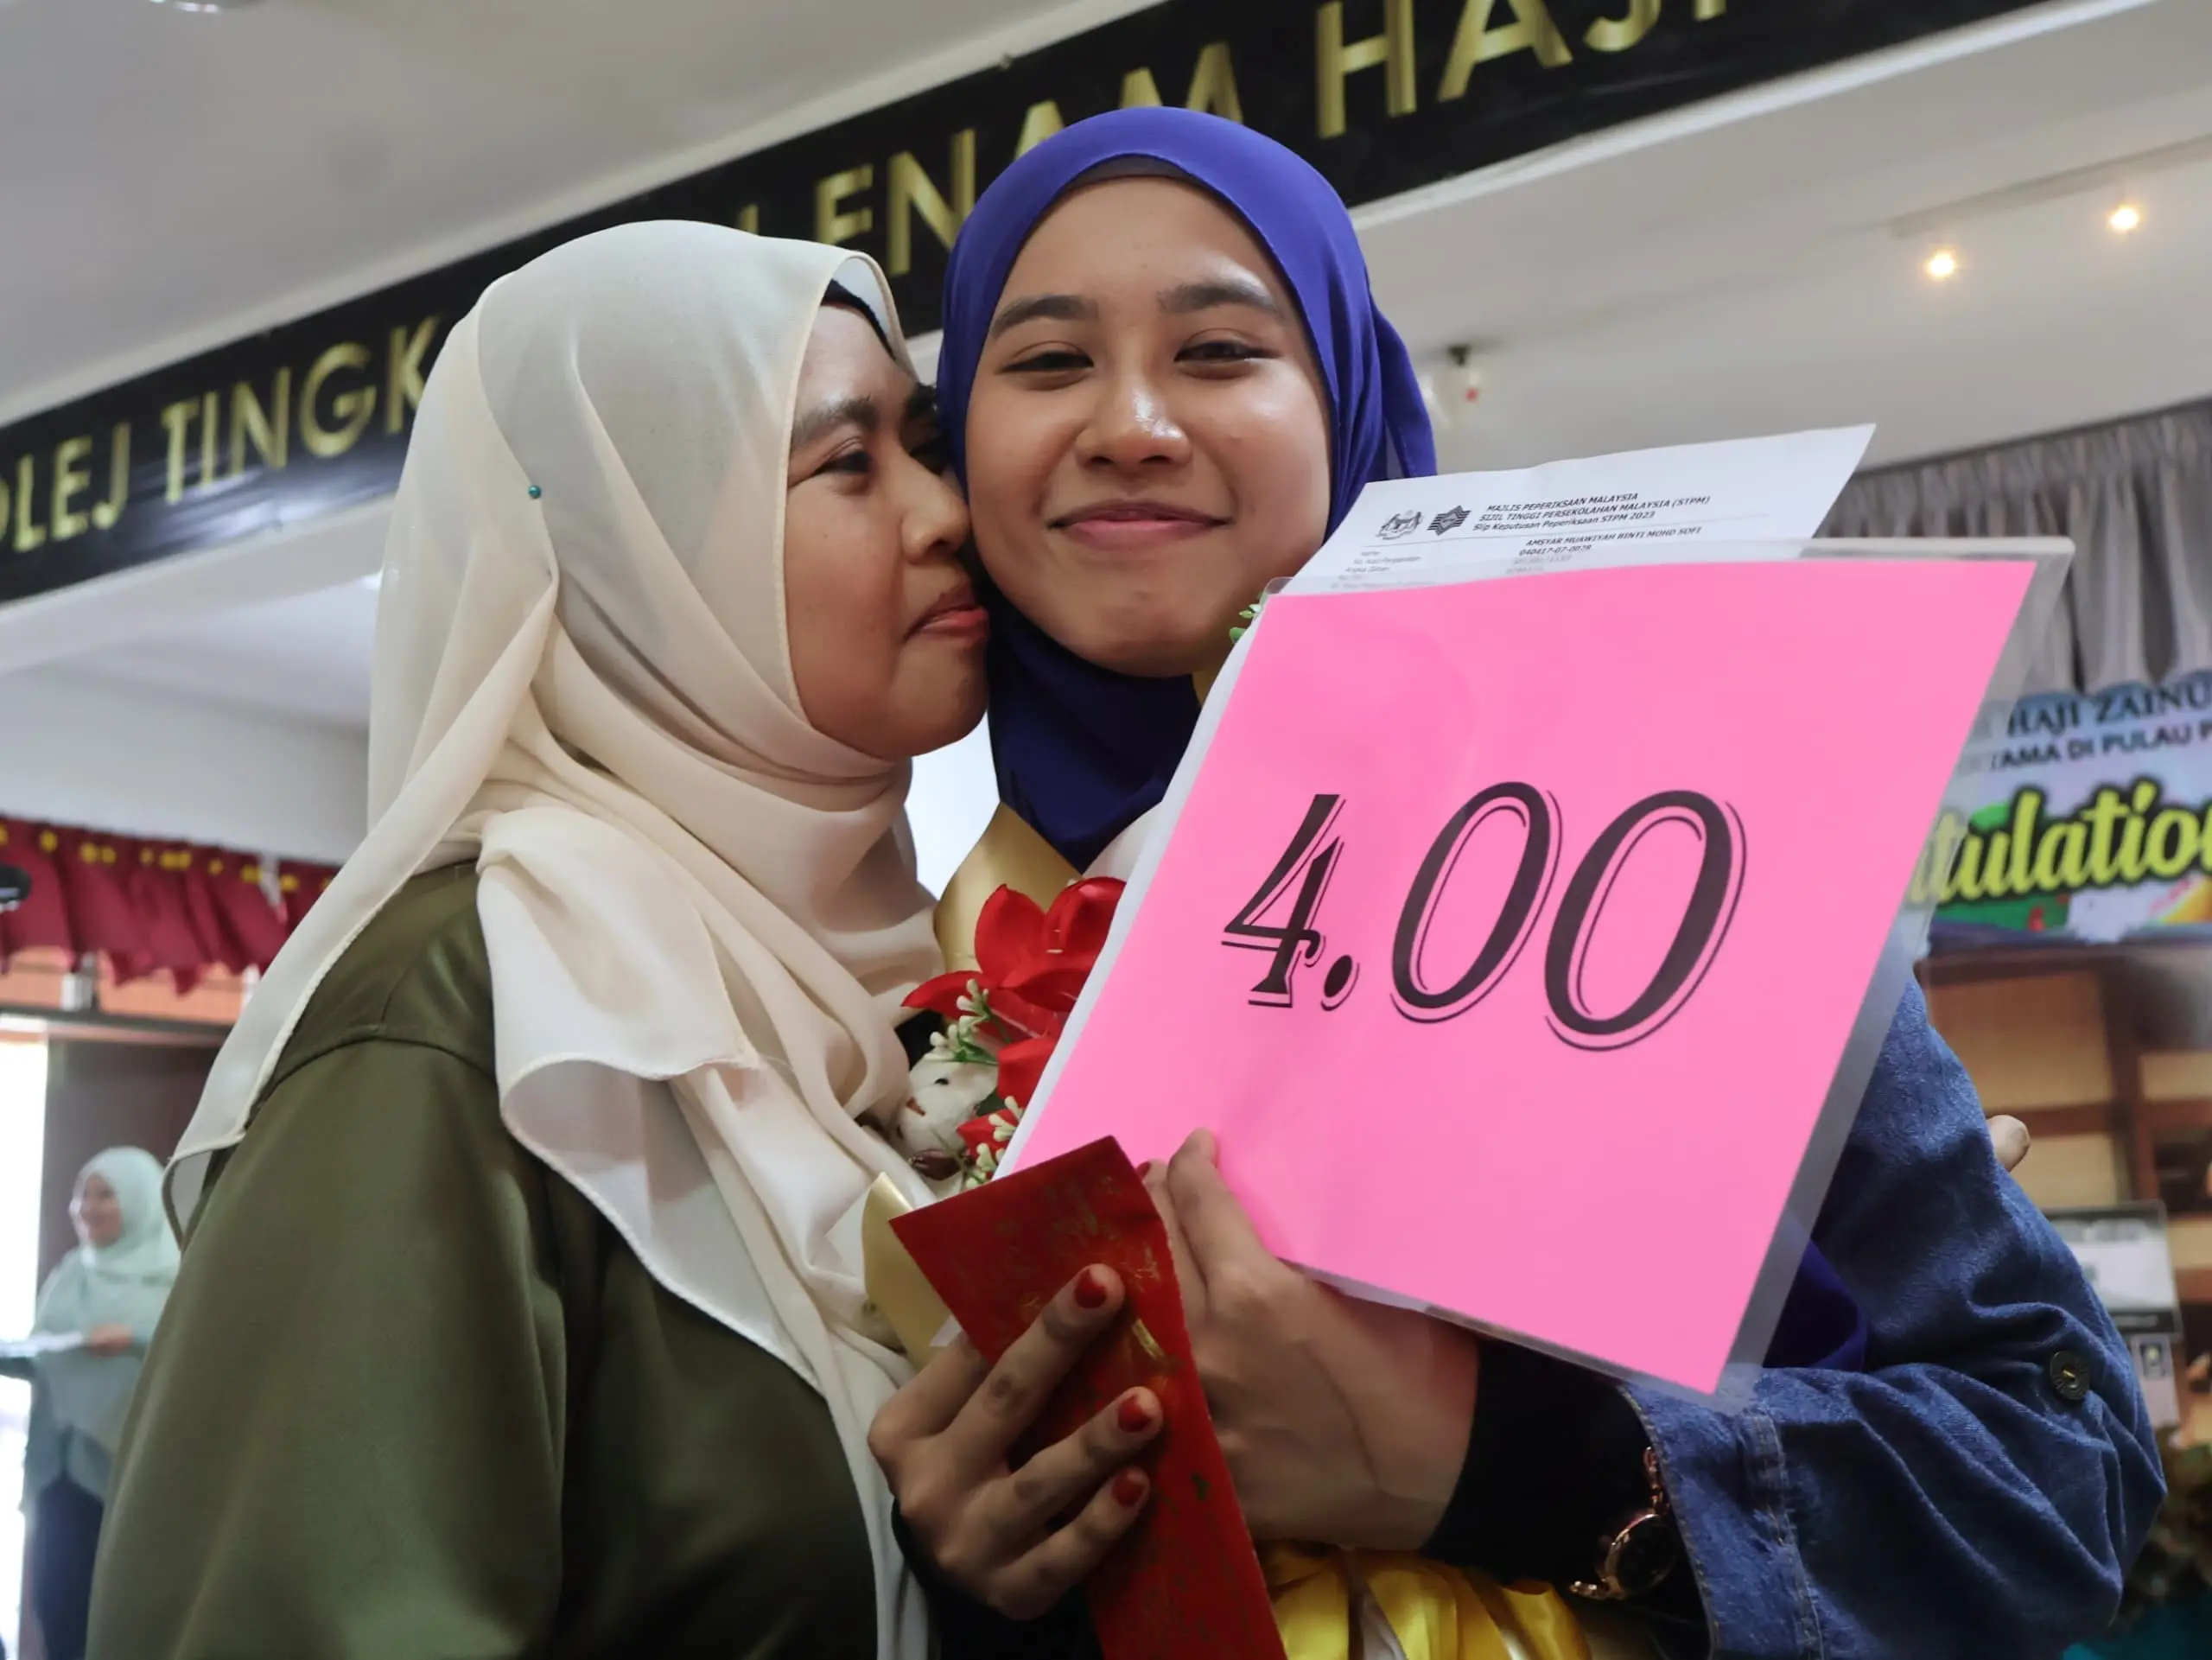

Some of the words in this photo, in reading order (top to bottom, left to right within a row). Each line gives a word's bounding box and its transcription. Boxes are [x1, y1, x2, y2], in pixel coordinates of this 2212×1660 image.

[0, 423, 131, 553] LEJ
[1316, 0, 1726, 139] HA
[1522, 497, 1587, 511] PEPERIKSAAN
[1588, 493, 1638, 504] MALAYSIA
[1541, 505, 1618, 518] PERSEKOLAHAN
[1618, 500, 1670, 512] MALAYSIA
[1671, 495, 1711, 508] (STPM)
[1491, 522, 1541, 531] Keputusan
[1599, 513, 1628, 523] STPM
[2102, 723, 2192, 754] PULAU
[1910, 778, 2212, 904] tulatio
[1221, 781, 1747, 1052] 4.00
